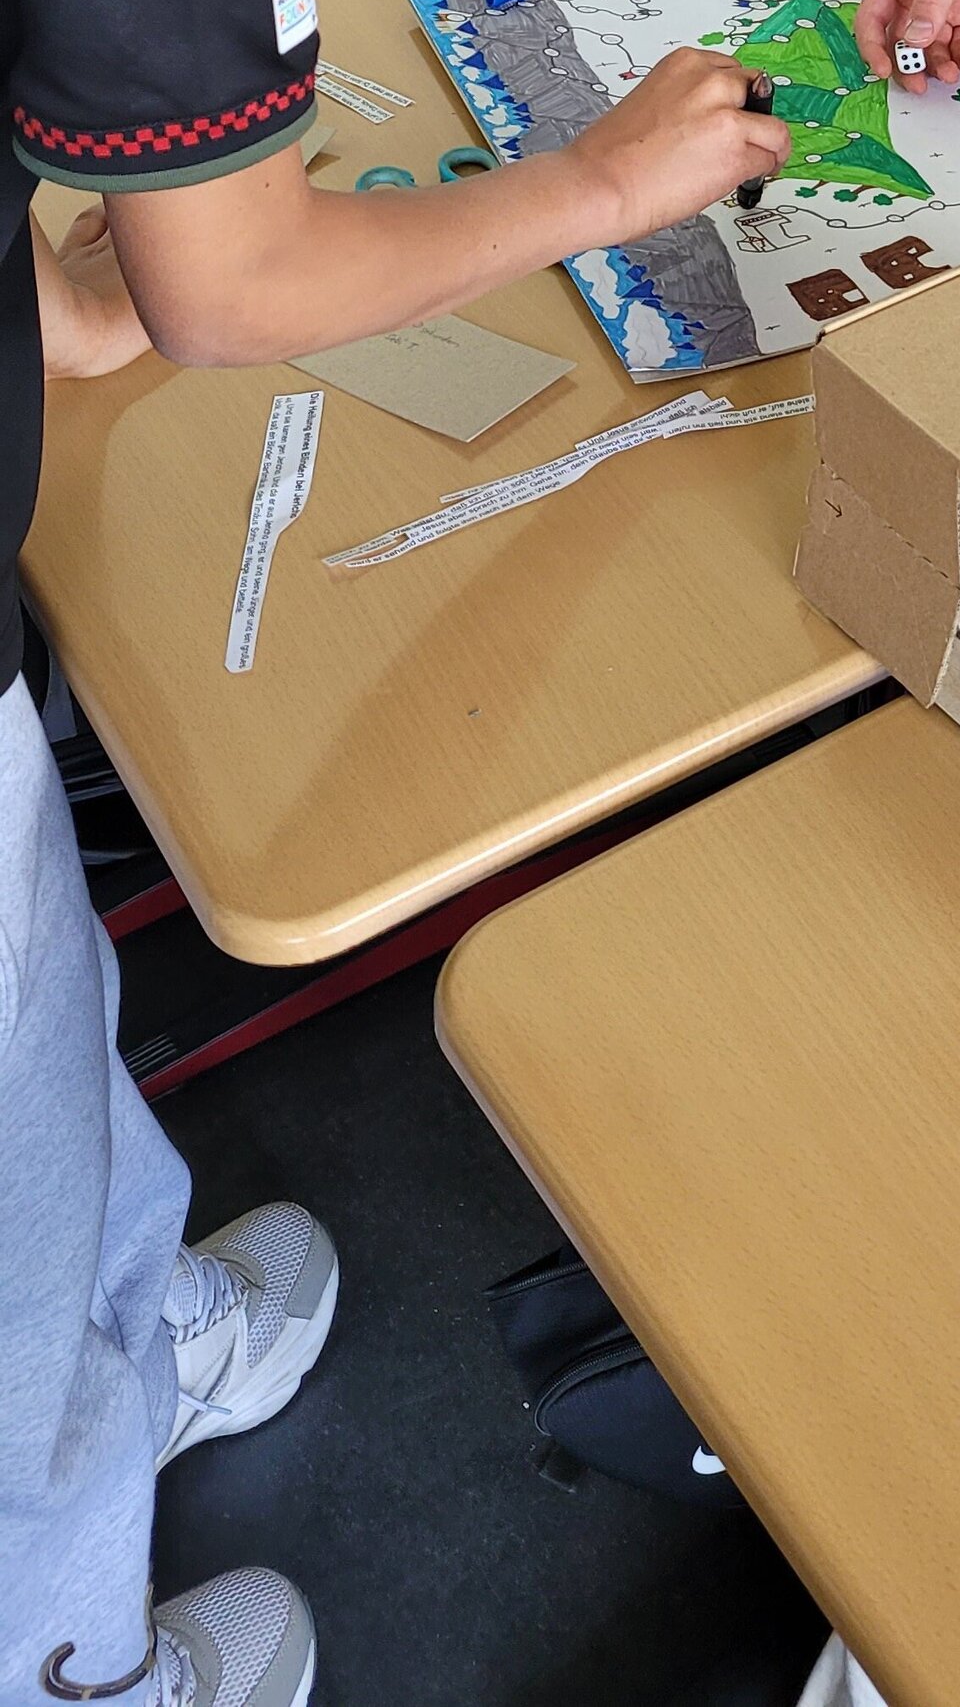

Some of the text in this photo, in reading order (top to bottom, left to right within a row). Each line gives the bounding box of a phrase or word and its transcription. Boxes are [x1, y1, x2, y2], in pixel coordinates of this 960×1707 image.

[309, 392, 319, 404] Die
[698, 401, 727, 414] alsbald
[787, 398, 809, 406] stehe
[284, 403, 294, 415] Und
[302, 405, 317, 431] Heilung
[586, 435, 604, 445] Und
[605, 425, 628, 436] Jesus
[670, 399, 686, 408] und
[301, 432, 312, 451] eines
[296, 452, 309, 478] Blinden
[294, 479, 304, 492] bei
[421, 519, 445, 532] Jesus
[447, 512, 466, 521] aber
[468, 499, 497, 513] sprach
[529, 475, 553, 487] Gehe
[569, 459, 588, 469] dein
[384, 540, 416, 558] sehend
[417, 533, 434, 542] und
[500, 498, 514, 507] auf
[515, 491, 534, 501] dem
